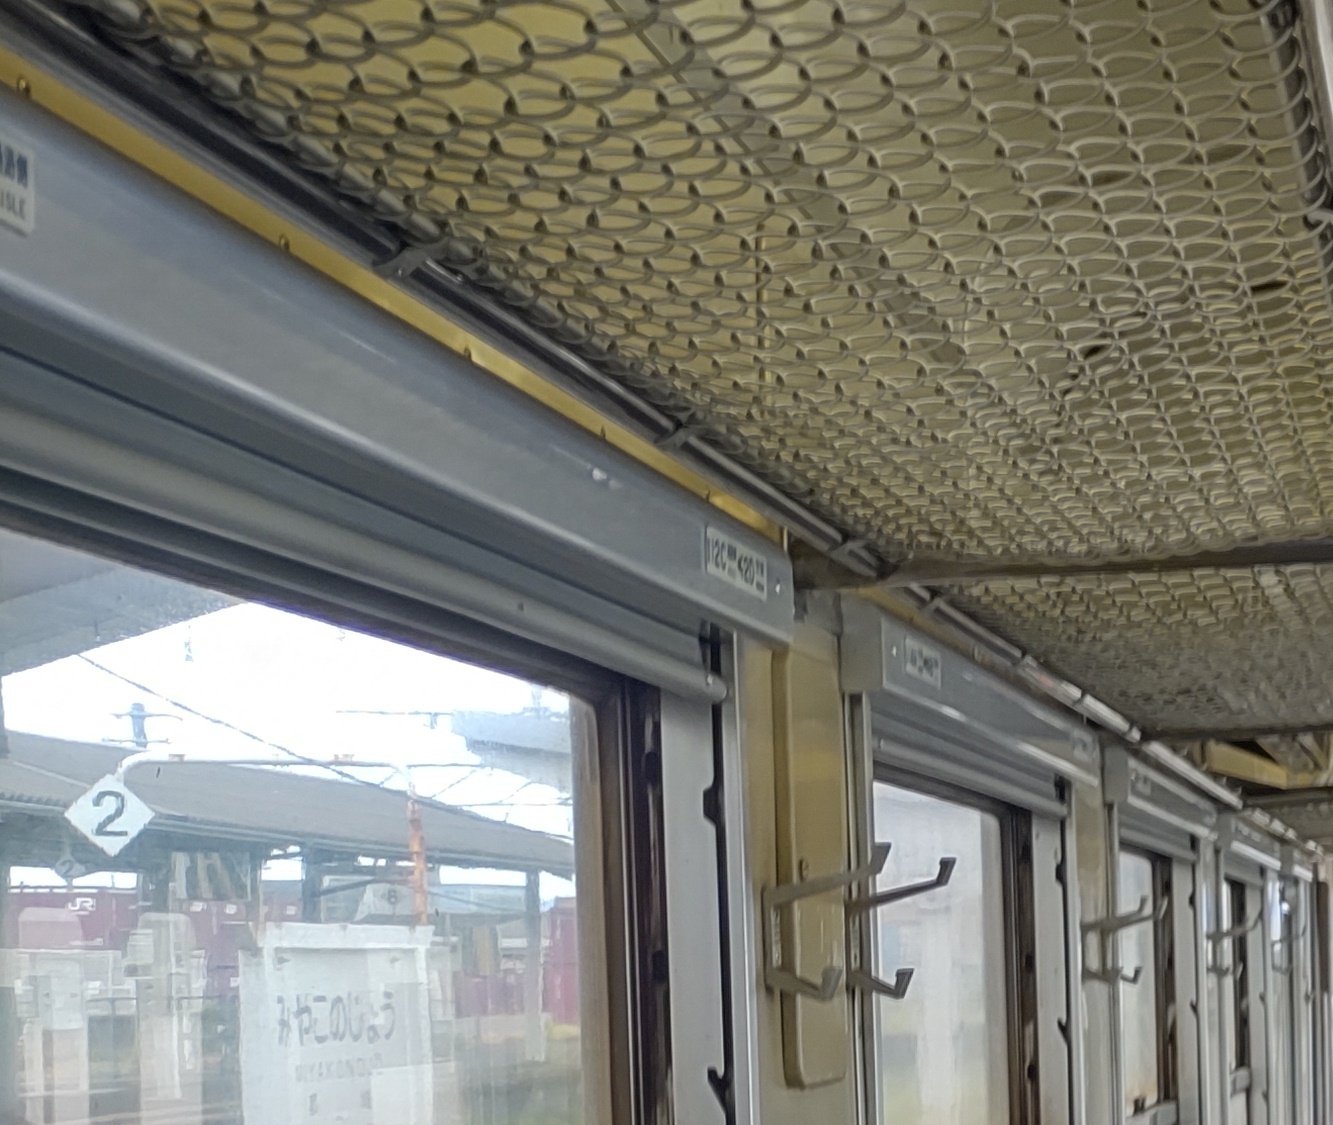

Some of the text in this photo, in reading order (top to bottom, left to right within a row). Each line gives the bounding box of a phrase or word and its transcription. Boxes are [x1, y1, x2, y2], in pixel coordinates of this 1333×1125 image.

[92, 790, 128, 837] 2
[58, 859, 75, 878] 2
[67, 897, 96, 911] JR
[276, 990, 396, 1047] みやこのじょう
